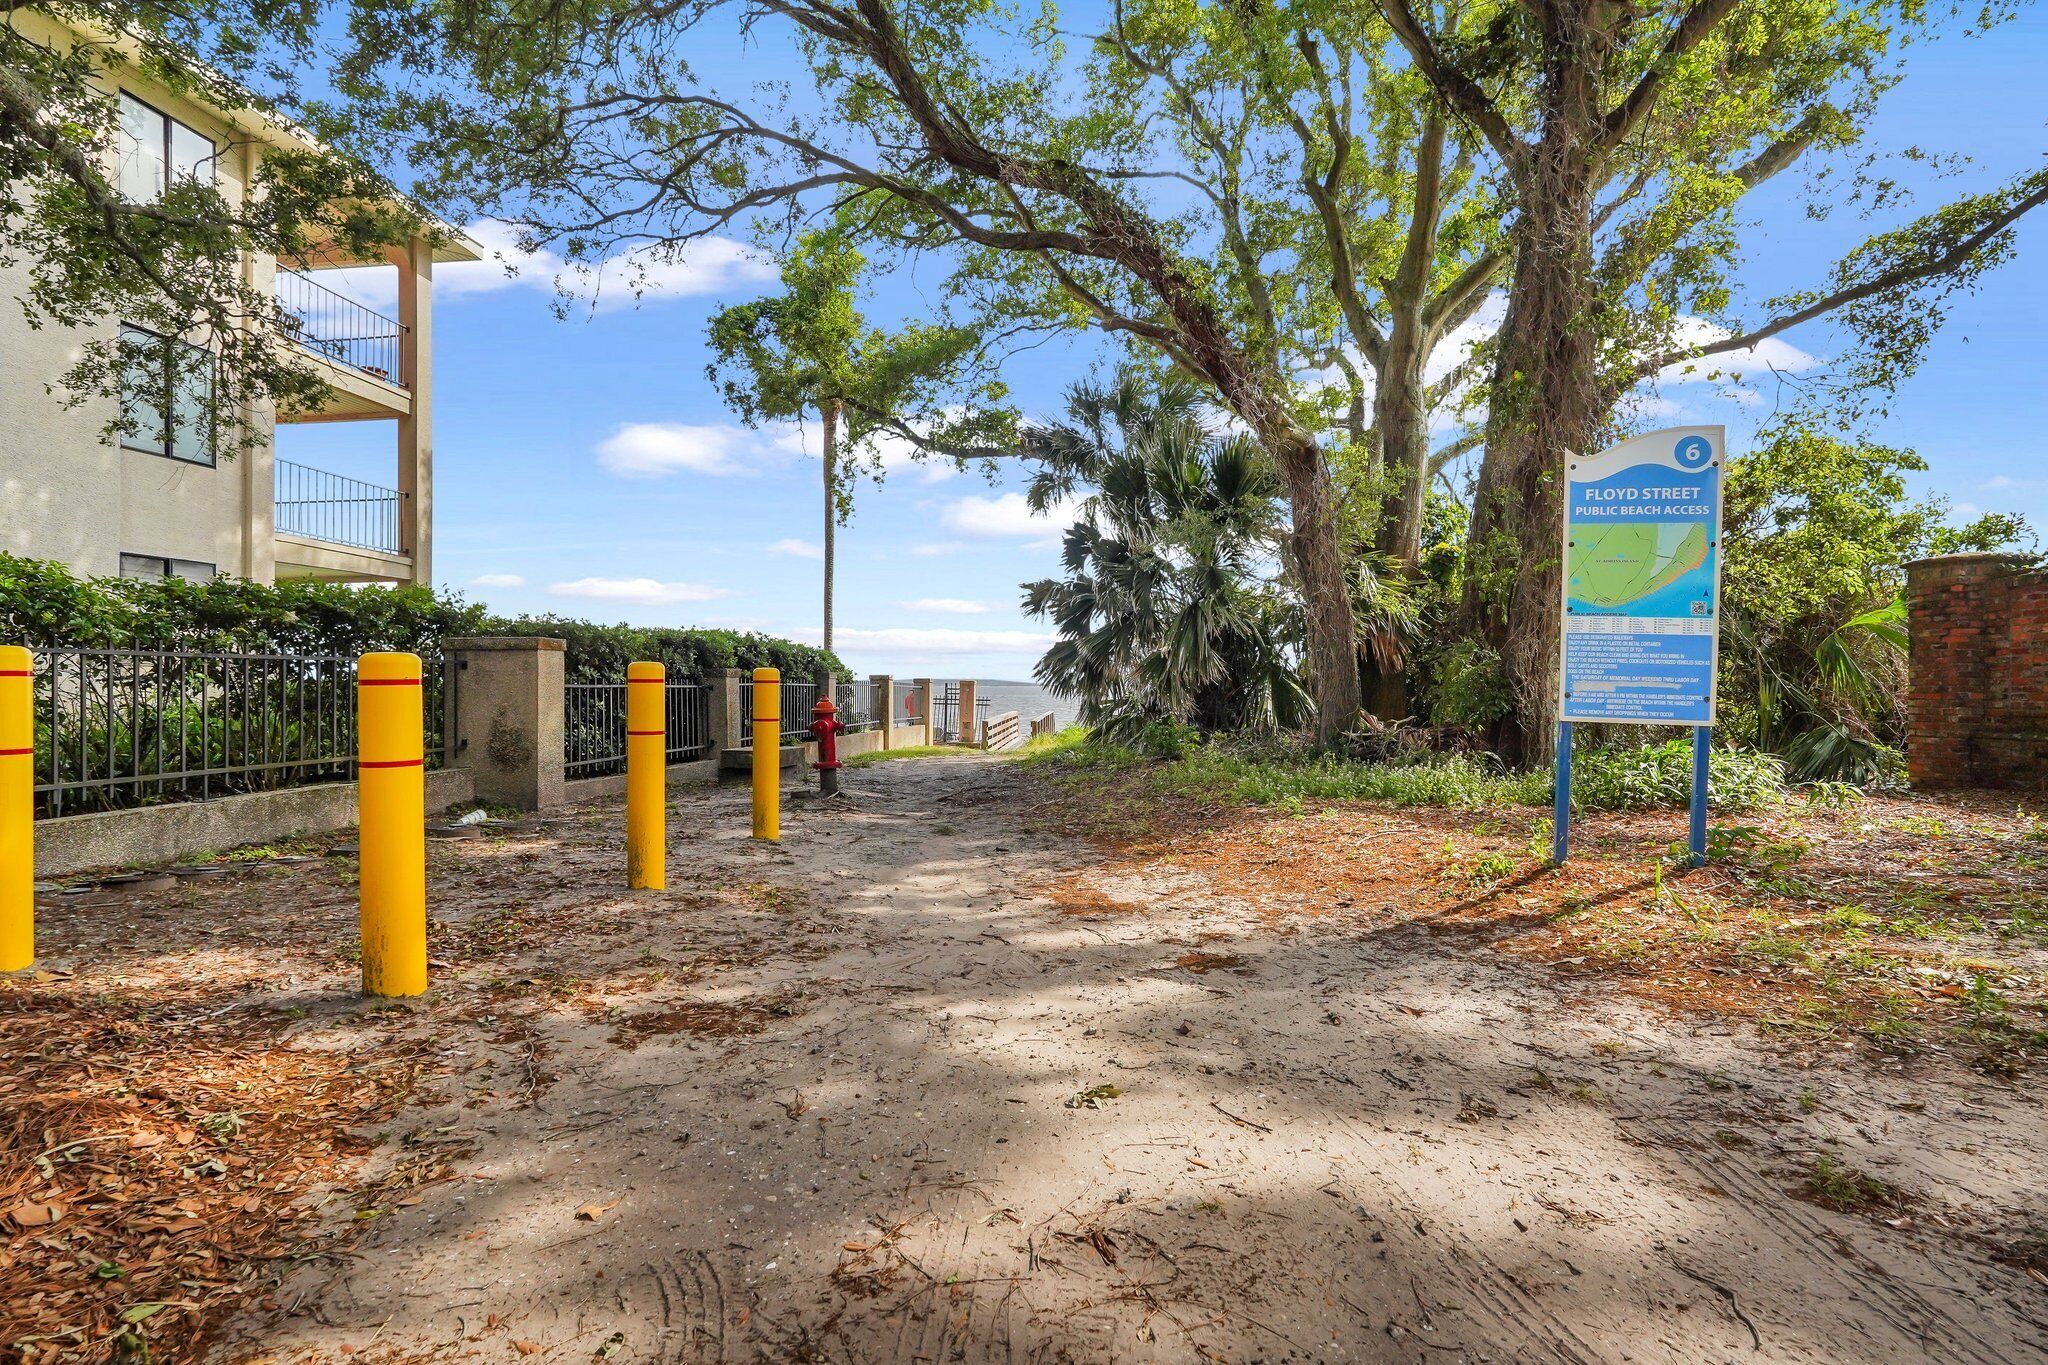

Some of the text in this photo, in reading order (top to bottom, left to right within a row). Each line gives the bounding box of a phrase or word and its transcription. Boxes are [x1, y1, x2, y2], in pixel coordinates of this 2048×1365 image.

[1685, 443, 1700, 461] 6
[1585, 487, 1701, 501] FLOYD STREET
[1575, 505, 1710, 516] PUBLIC BEACH ACCESS
